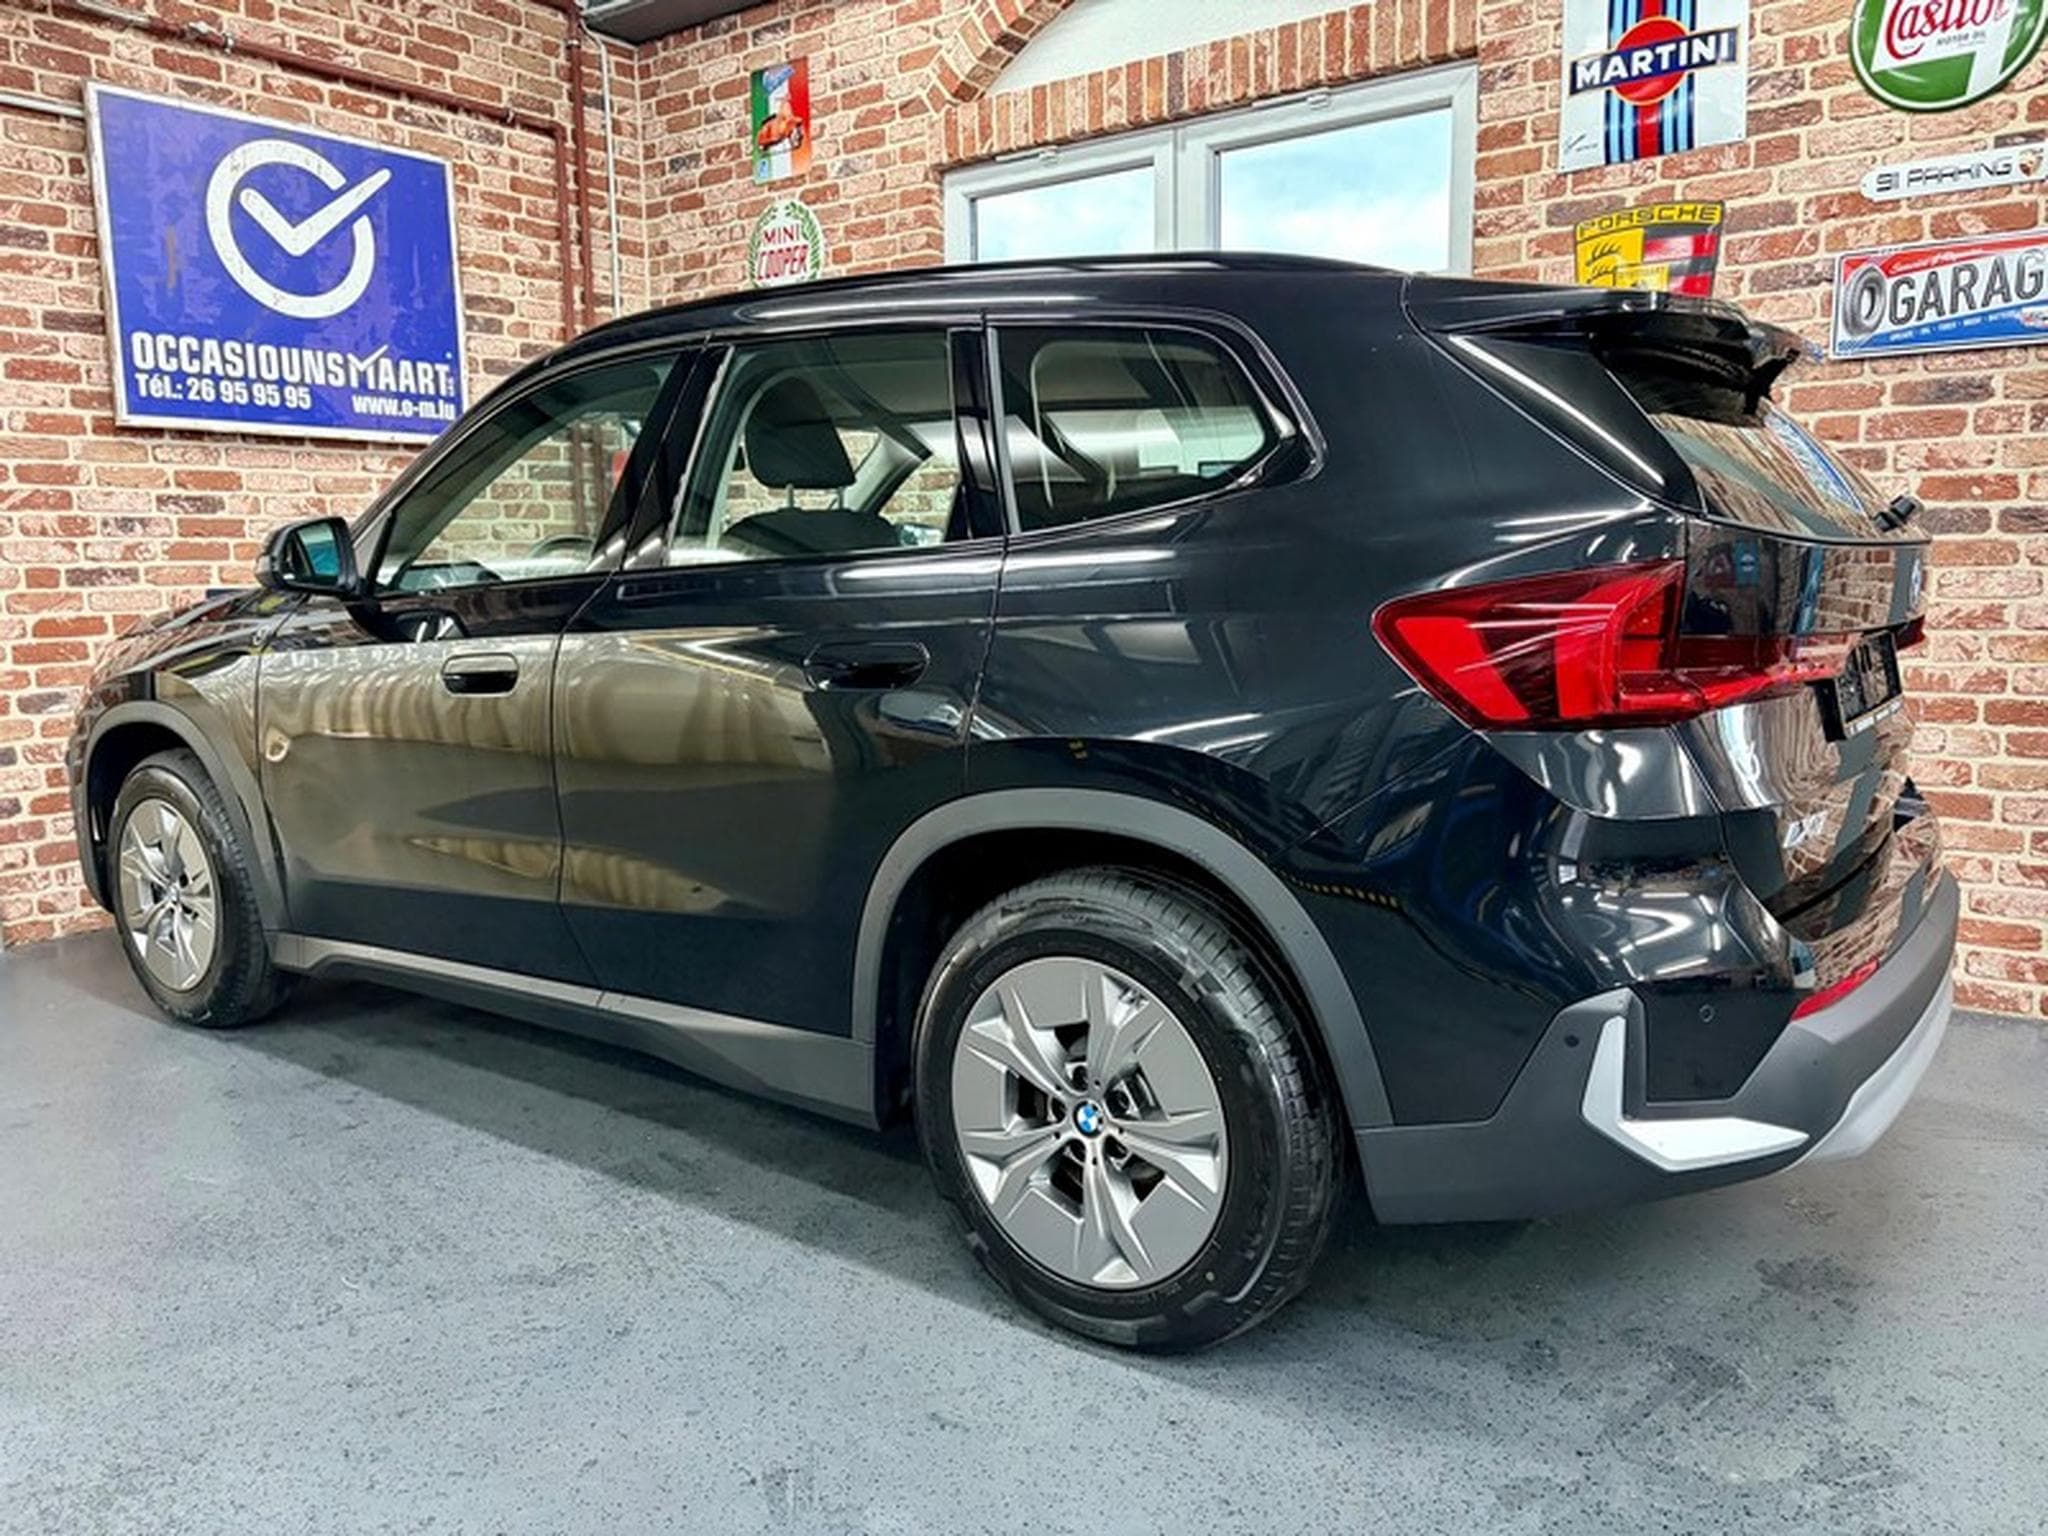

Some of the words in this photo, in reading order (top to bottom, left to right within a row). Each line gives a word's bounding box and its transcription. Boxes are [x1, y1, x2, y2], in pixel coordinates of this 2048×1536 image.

[1575, 32, 1729, 90] MARTINI
[1907, 156, 2013, 188] PARKING
[763, 223, 800, 246] MINI
[1578, 206, 1719, 237] PORSCHE
[757, 244, 808, 280] COOPER
[1888, 248, 2045, 326] GARAG
[131, 331, 449, 397] OCCASIOUNSMAART
[186, 377, 216, 402] 26
[219, 379, 249, 405] 95
[252, 383, 281, 407] 95
[284, 385, 312, 410] 95
